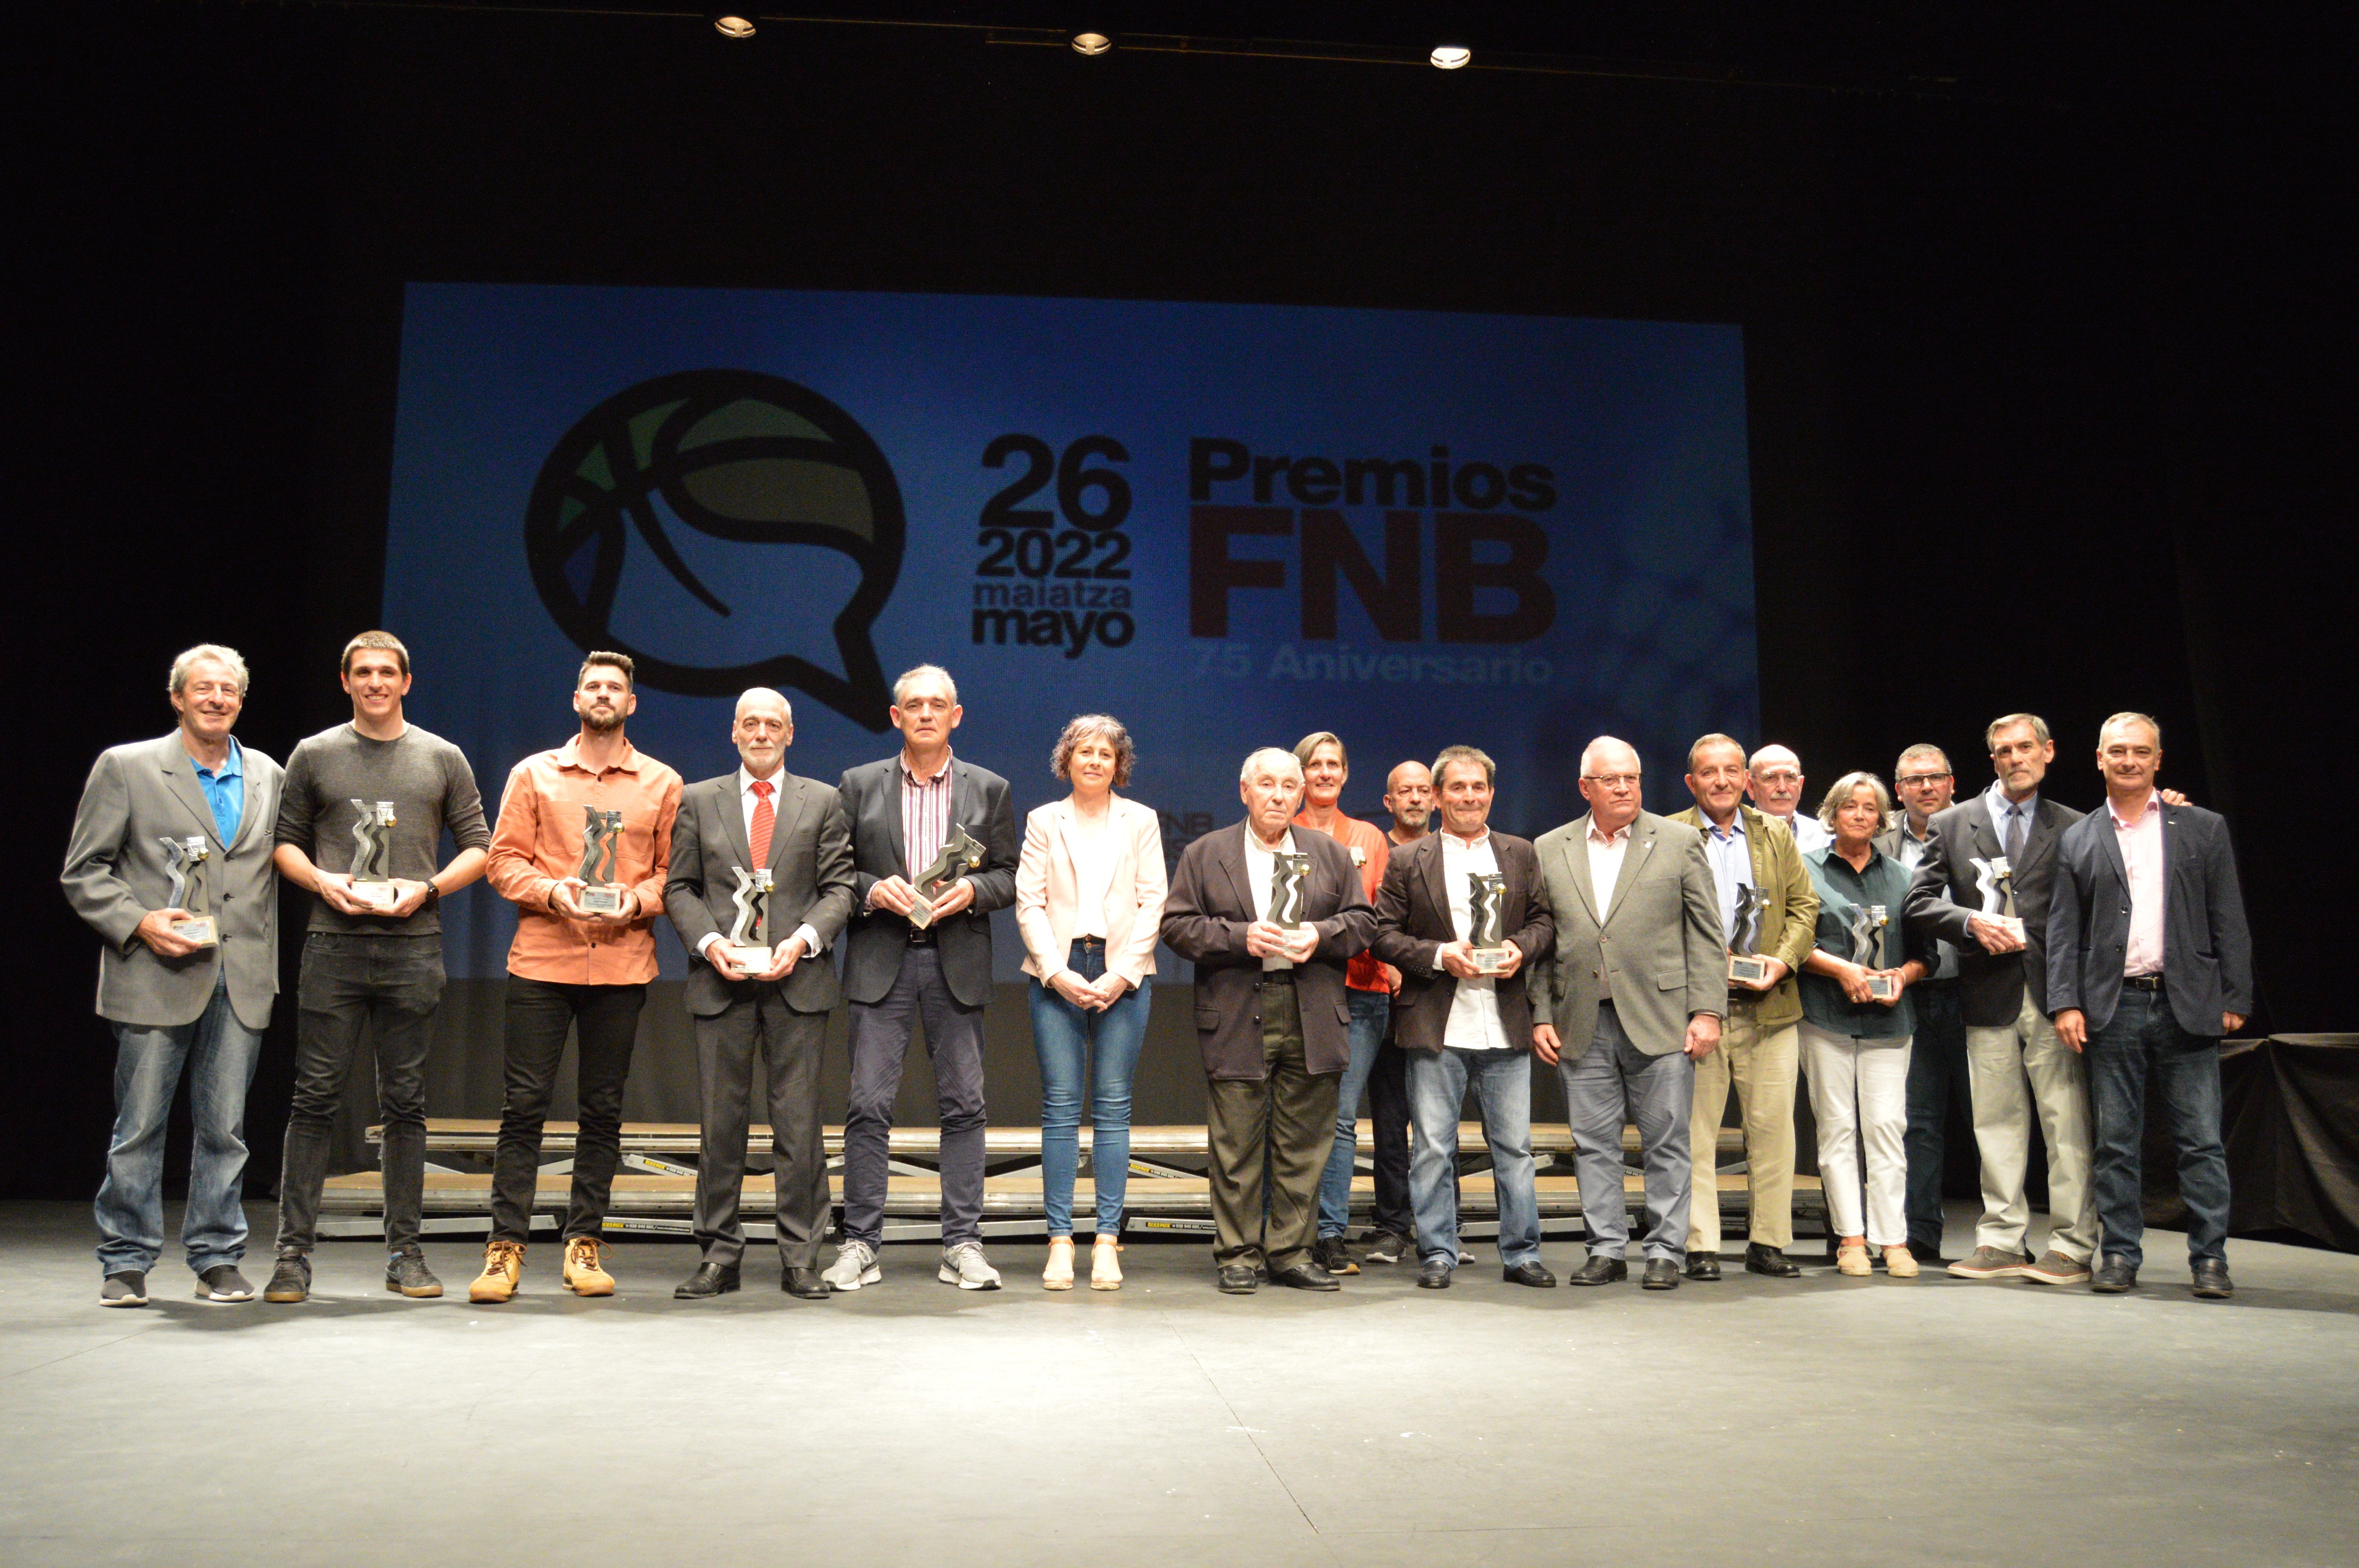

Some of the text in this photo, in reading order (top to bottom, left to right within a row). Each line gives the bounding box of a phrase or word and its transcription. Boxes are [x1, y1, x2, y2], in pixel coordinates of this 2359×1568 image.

[980, 433, 1132, 531] 26
[1190, 437, 1558, 512] Premios
[976, 528, 1132, 579] 2022
[1190, 505, 1558, 645] FNB
[973, 578, 1132, 608] maiatza
[972, 608, 1135, 659] mayo
[1188, 642, 1554, 685] 75 Aniversario
